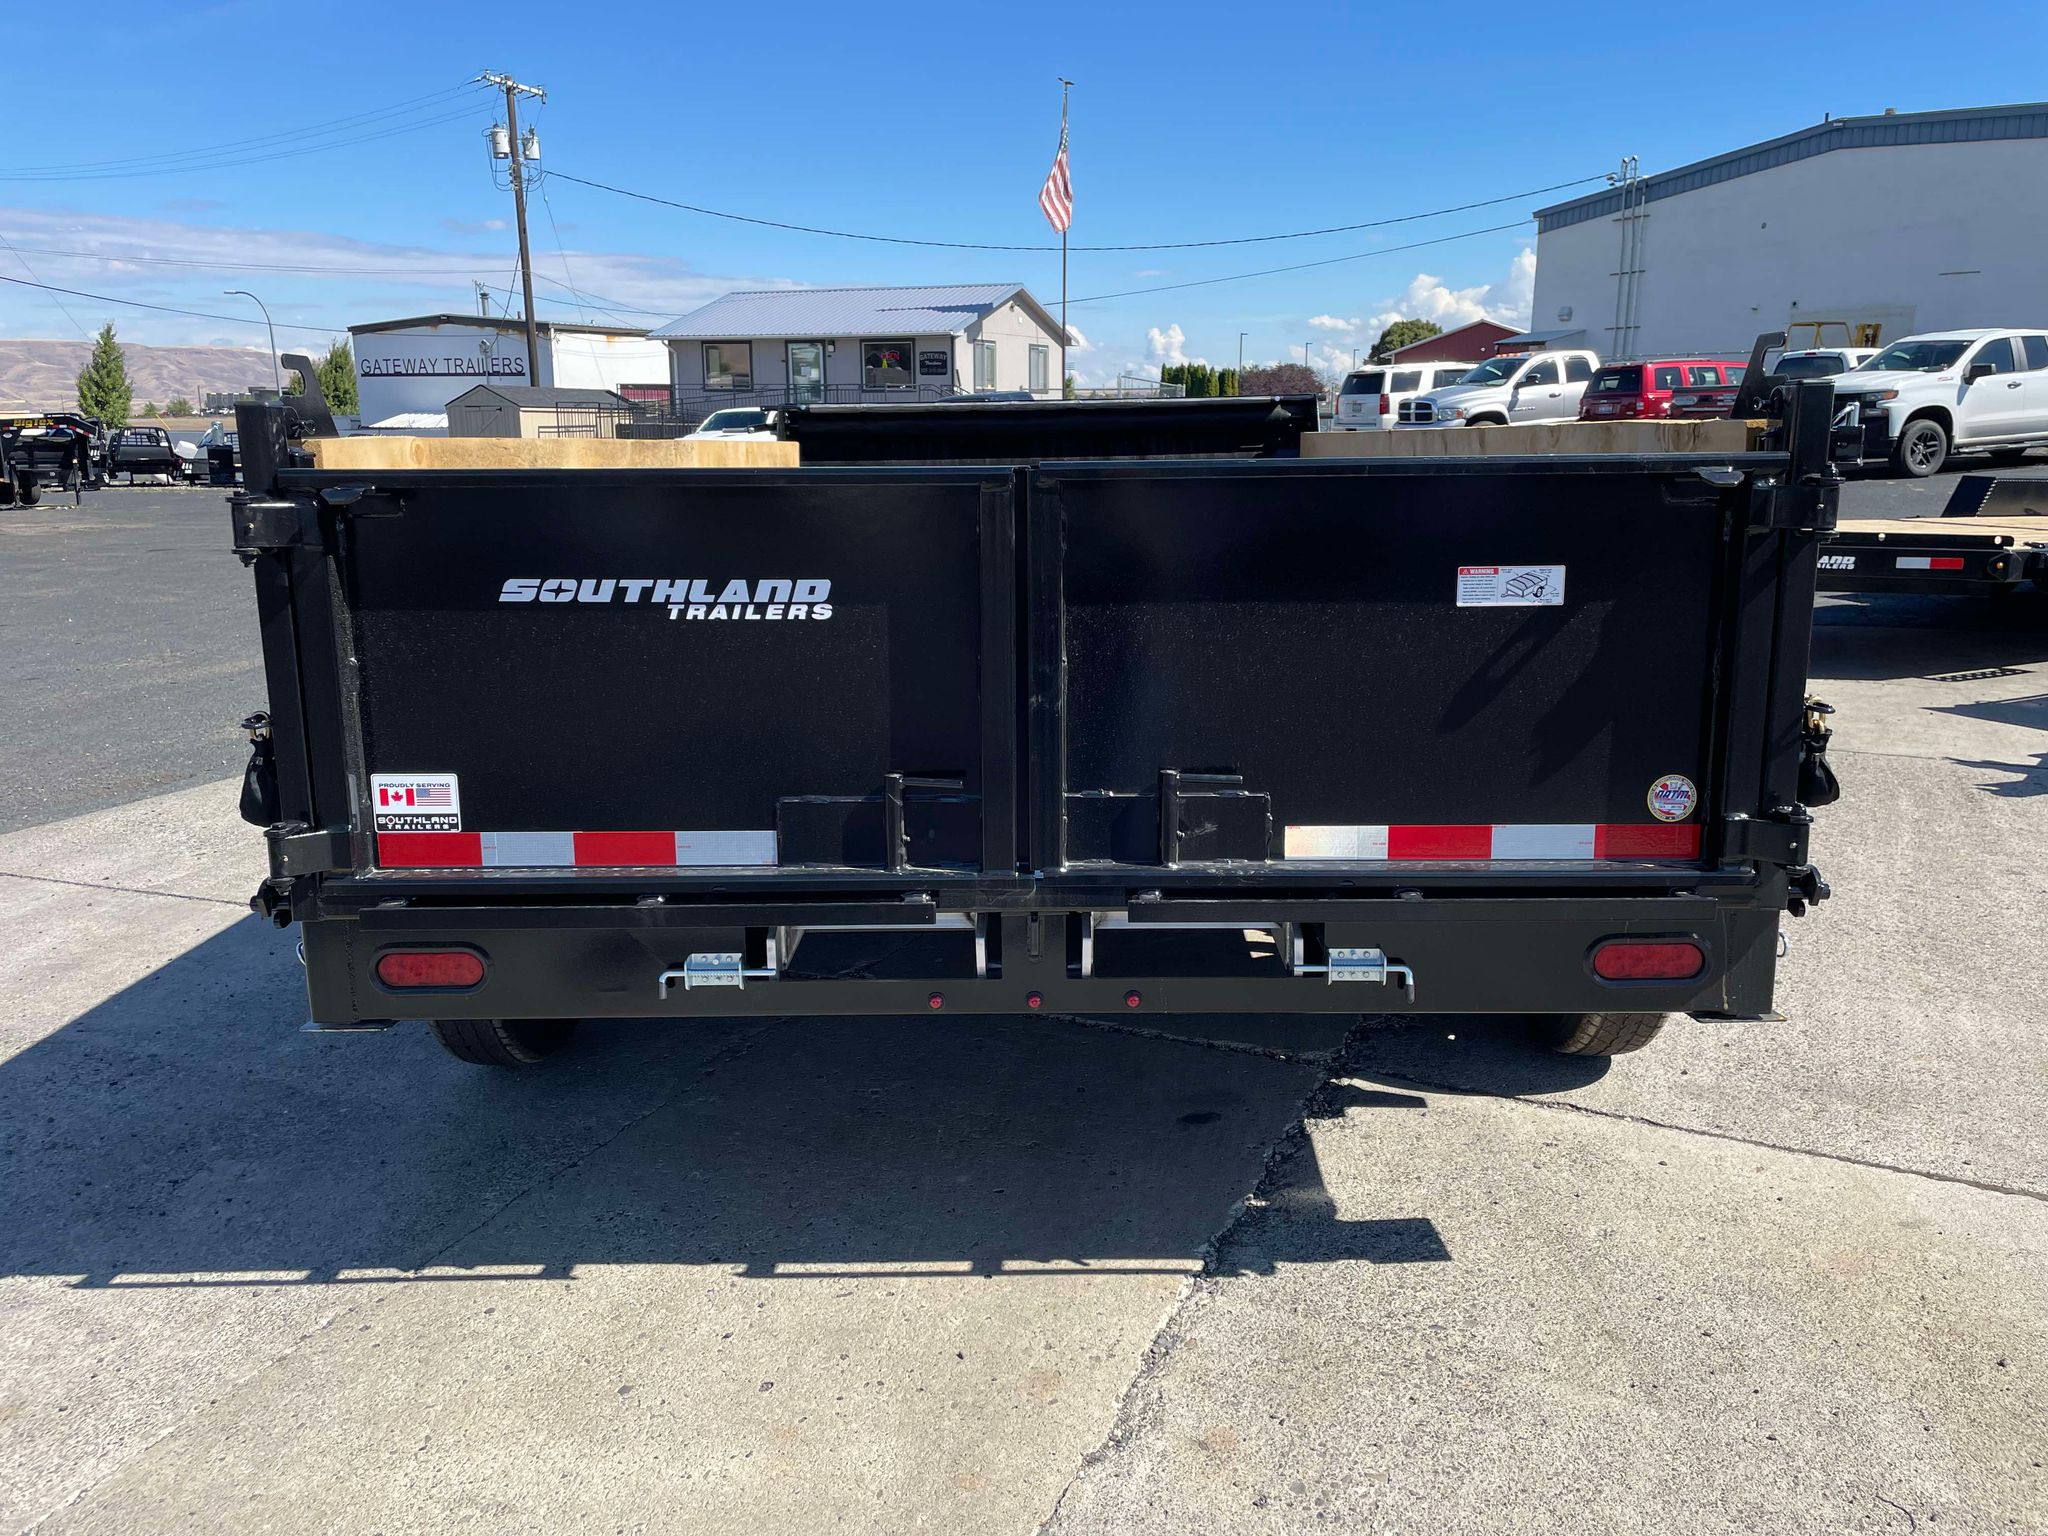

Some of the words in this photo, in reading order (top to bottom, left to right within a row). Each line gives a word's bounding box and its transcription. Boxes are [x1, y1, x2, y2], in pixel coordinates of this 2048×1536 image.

[361, 358, 439, 374] GATEWAY
[443, 357, 525, 374] TRAILERS
[498, 578, 832, 603] SOUTHLAND
[667, 603, 833, 620] TRAILERS
[377, 815, 458, 825] SOUTHLAND
